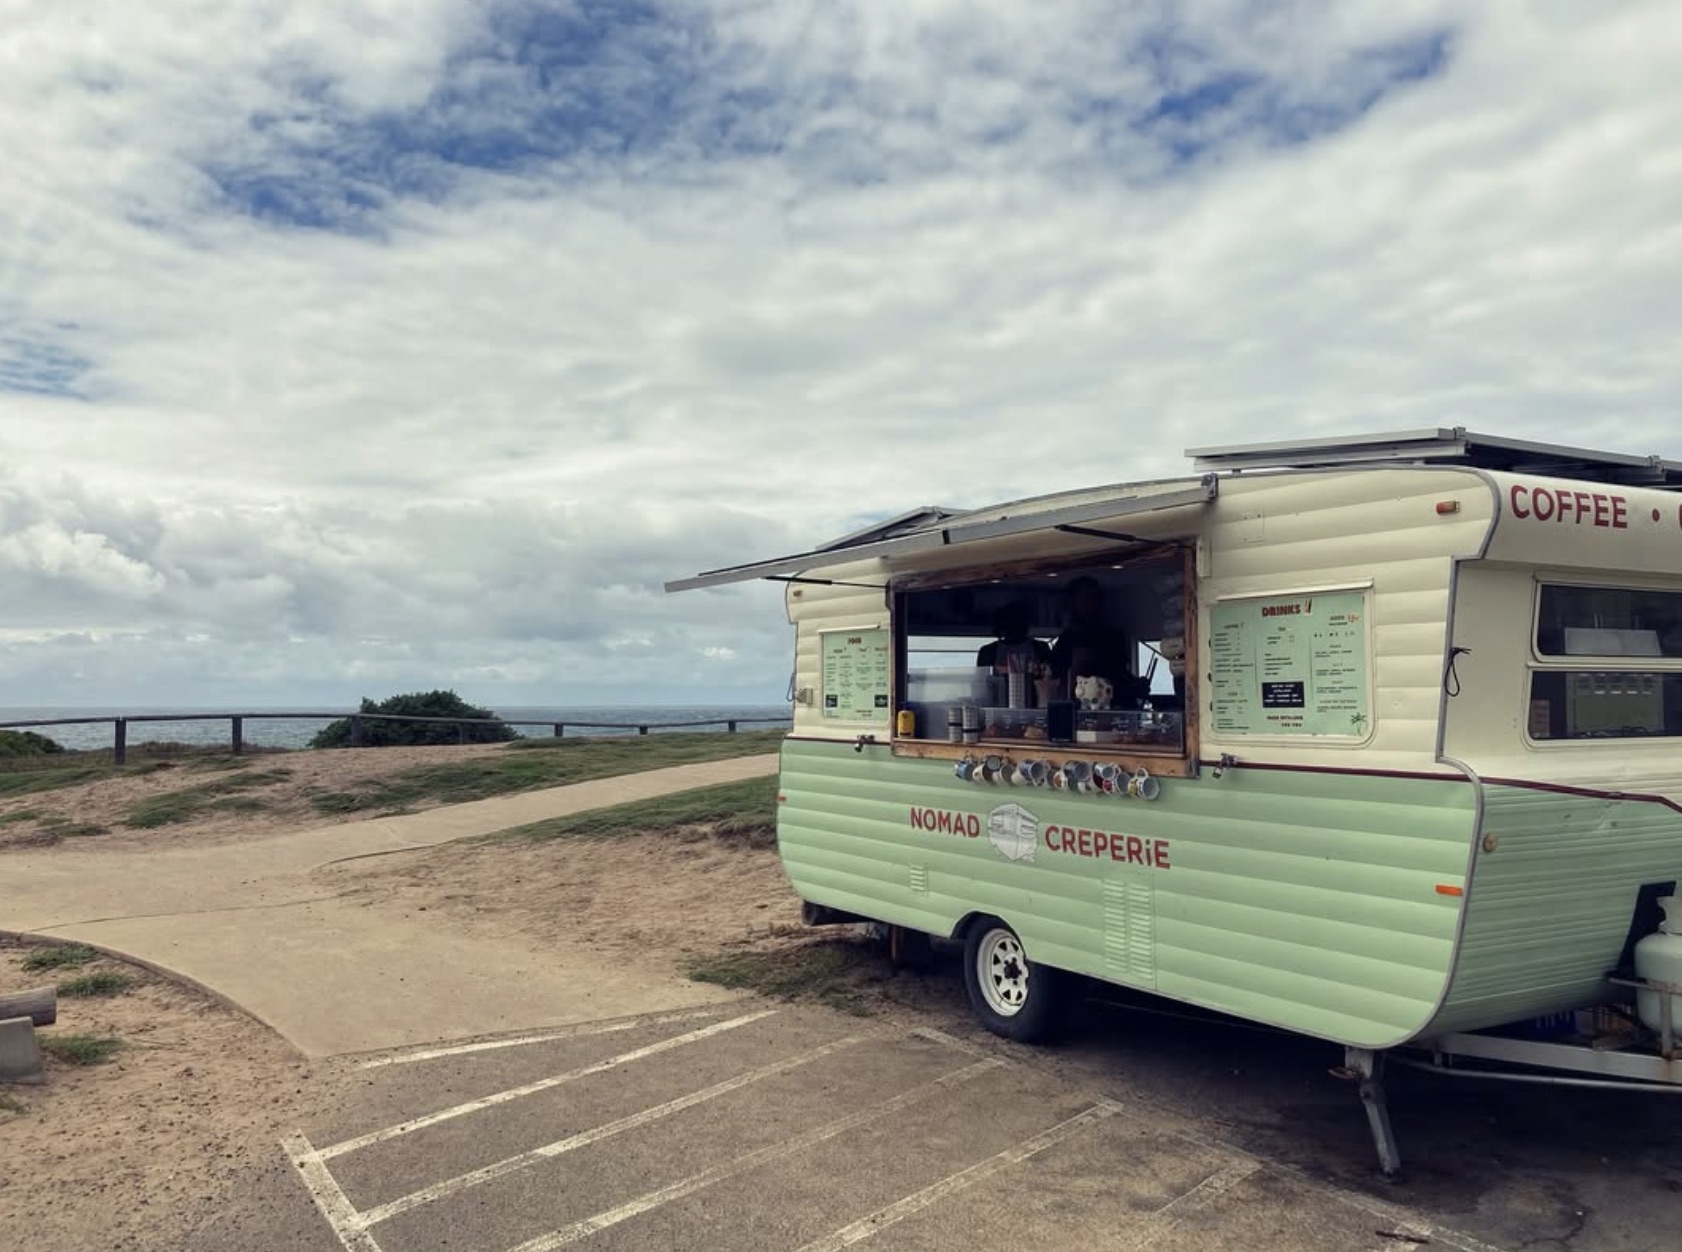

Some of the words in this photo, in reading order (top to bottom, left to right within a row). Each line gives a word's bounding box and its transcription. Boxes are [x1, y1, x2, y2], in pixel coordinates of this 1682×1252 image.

[1510, 485, 1628, 529] COFFEE
[1262, 604, 1301, 617] DRINKS
[910, 807, 980, 838] NOMAD
